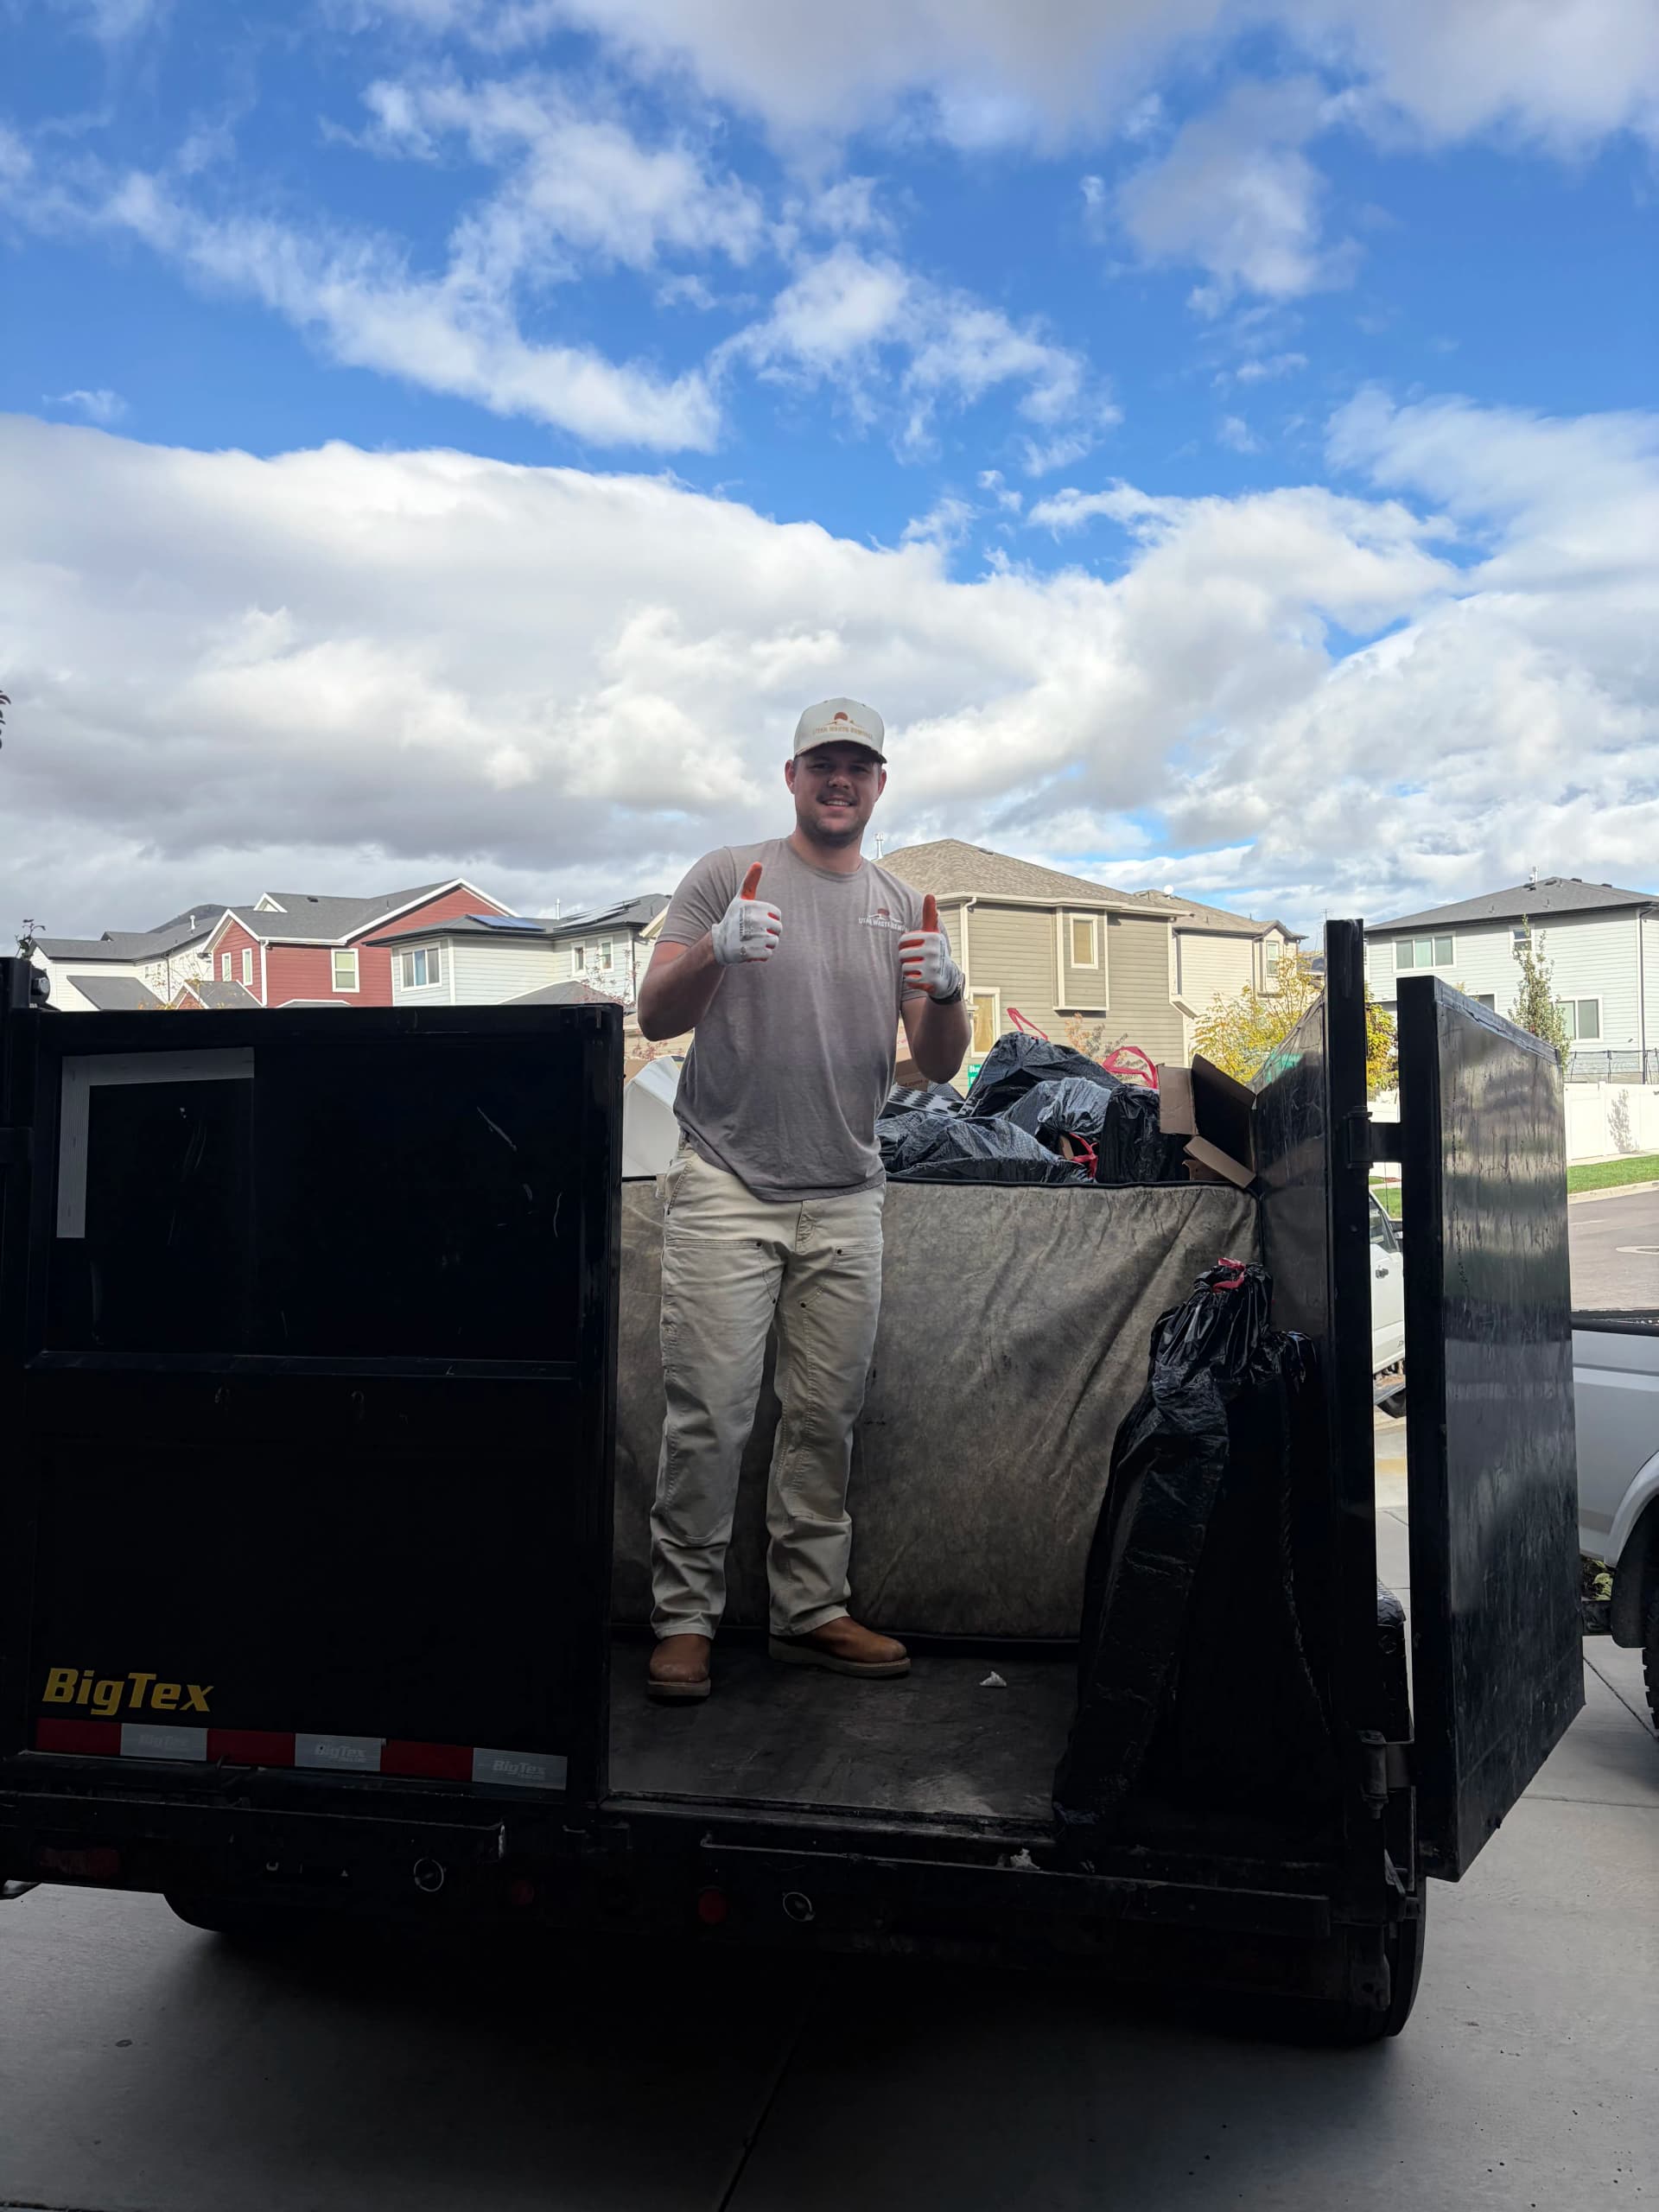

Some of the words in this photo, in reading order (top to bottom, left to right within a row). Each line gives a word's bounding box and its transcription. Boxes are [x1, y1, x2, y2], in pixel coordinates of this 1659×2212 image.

[41, 1667, 215, 1716] BigTex
[314, 1742, 366, 1758] BigTex
[493, 1760, 546, 1776] BigTex
